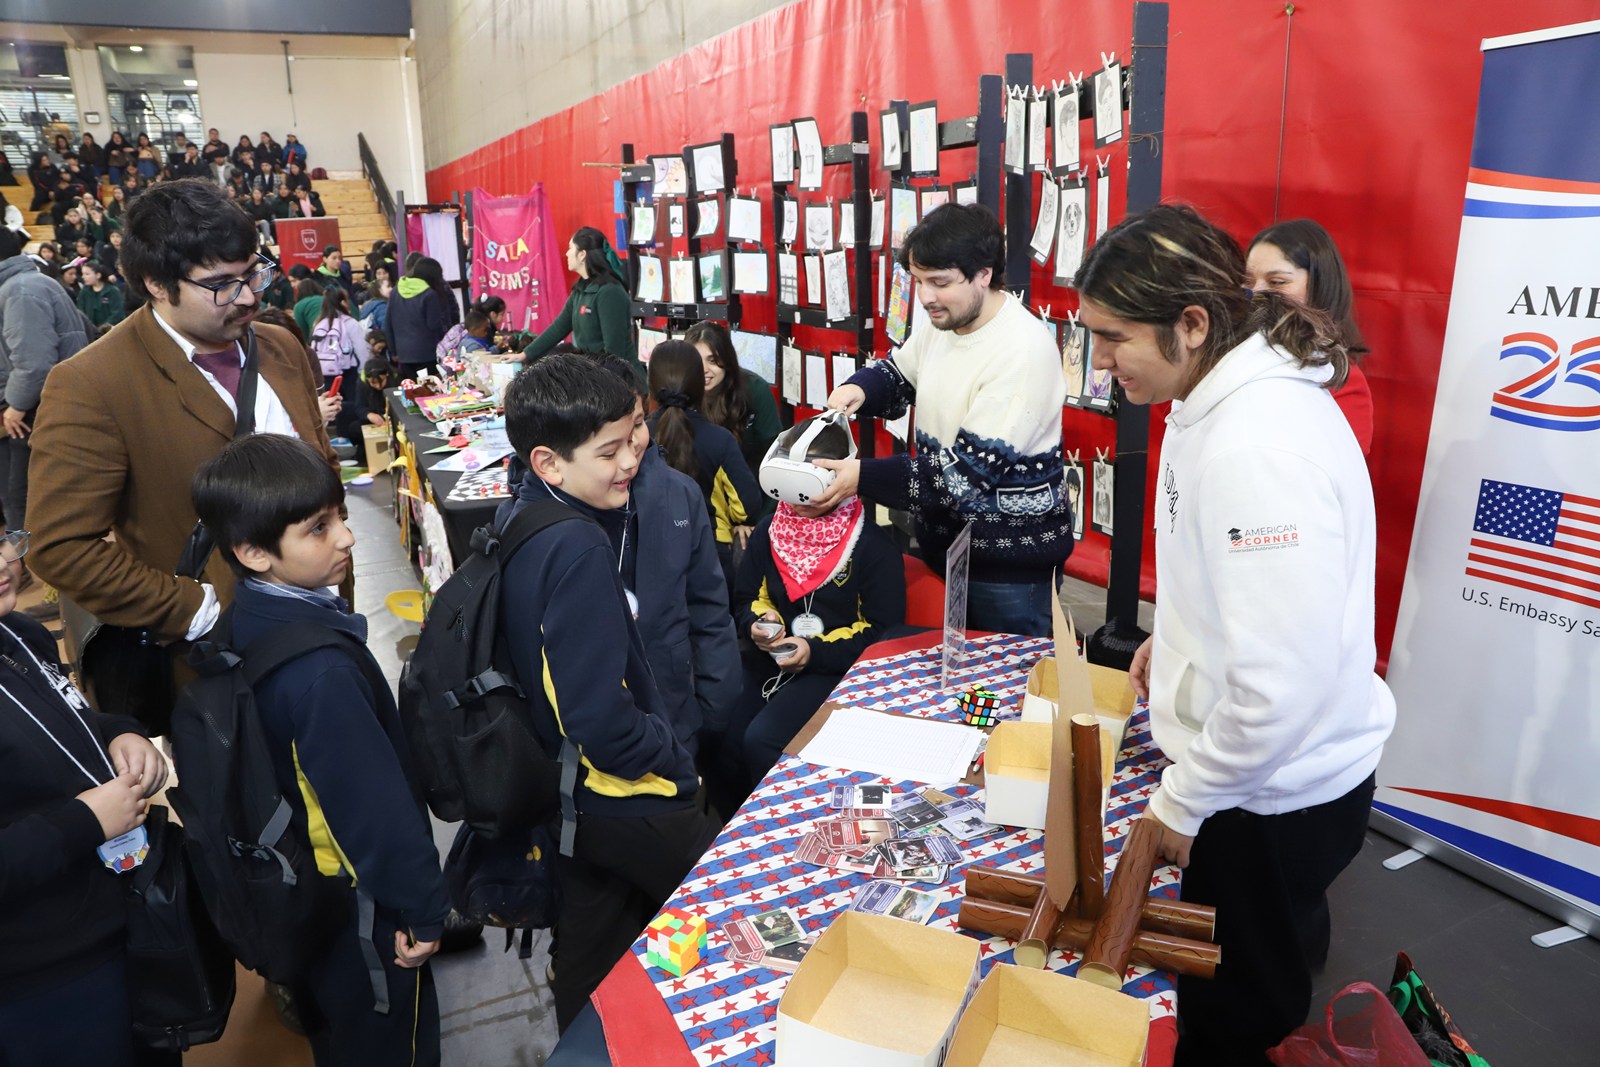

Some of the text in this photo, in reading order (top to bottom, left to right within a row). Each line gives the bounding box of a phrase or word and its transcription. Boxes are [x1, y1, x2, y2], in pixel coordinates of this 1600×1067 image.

[485, 238, 529, 262] SALA
[488, 266, 530, 290] SIMS
[1244, 524, 1297, 536] AMERICAN
[1244, 533, 1298, 545] CORNER
[1462, 587, 1492, 607] U.S.
[1499, 596, 1578, 633] Embassy
